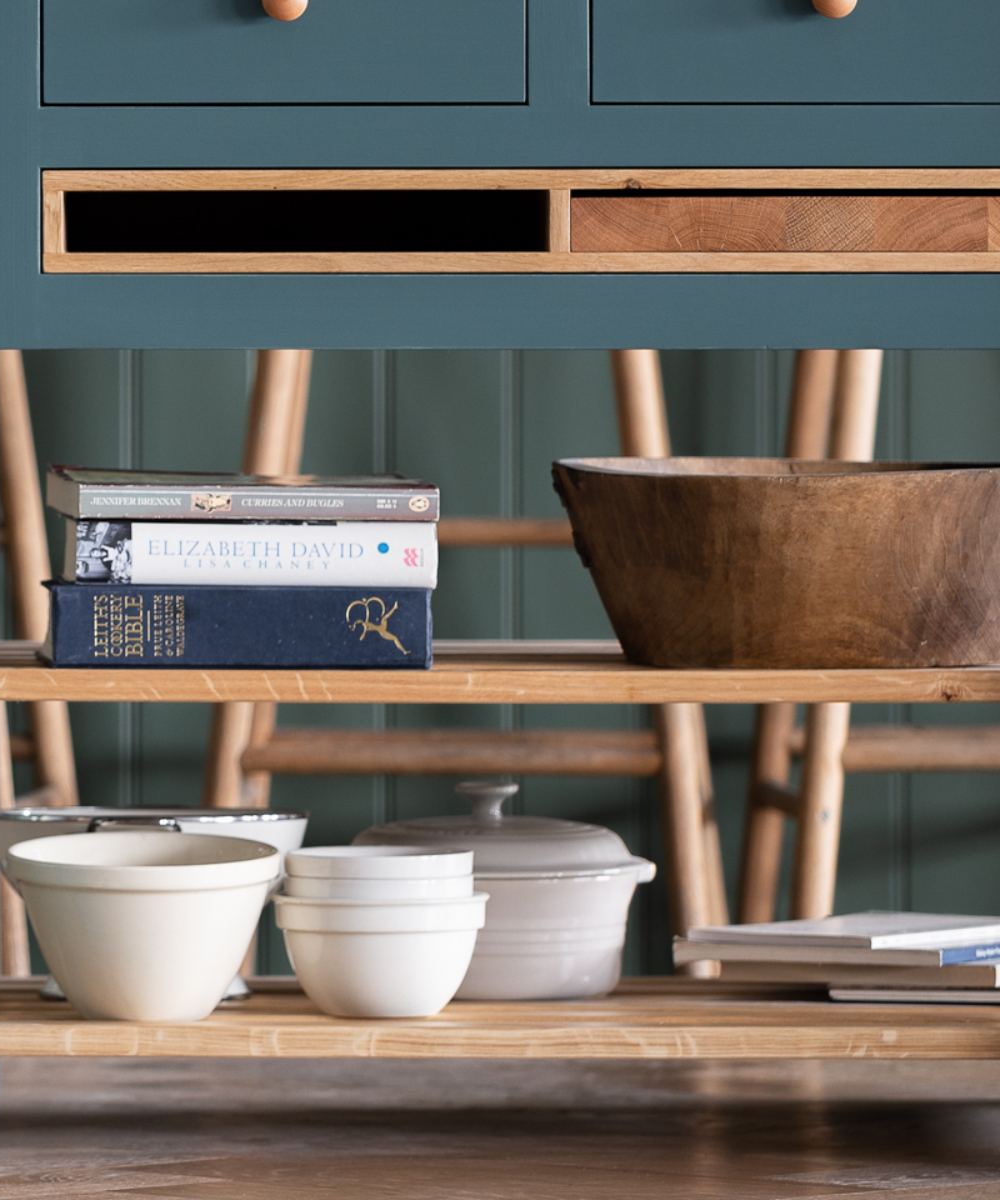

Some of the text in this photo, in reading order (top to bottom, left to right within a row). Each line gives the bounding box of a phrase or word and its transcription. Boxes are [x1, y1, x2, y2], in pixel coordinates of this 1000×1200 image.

[90, 497, 181, 506] JENNIFER BRENNAN
[241, 498, 344, 508] CURRIES AND BUGLES
[148, 540, 364, 558] ELIZABETH DAVID
[183, 559, 330, 570] LISA CHANEY
[93, 594, 109, 657] LEITH'S
[110, 594, 123, 657] COOKERY
[124, 594, 144, 657] BIBLE
[153, 594, 163, 657] PRUE LEITH
[164, 595, 174, 647] CAROLINE
[176, 595, 185, 657] WALDEGRAVE
